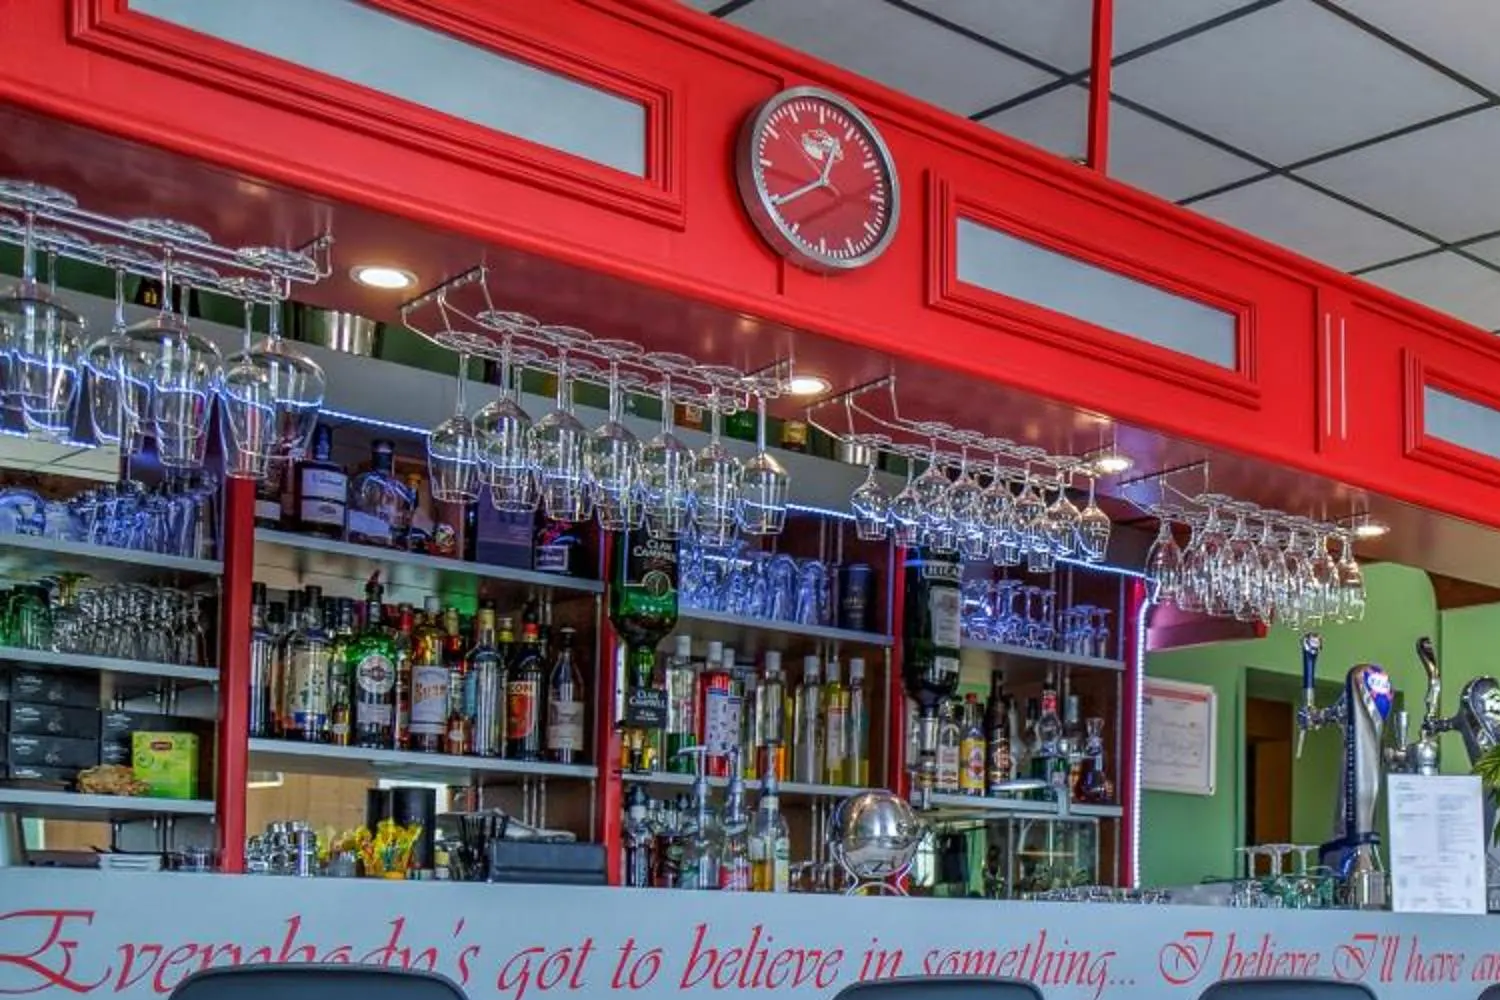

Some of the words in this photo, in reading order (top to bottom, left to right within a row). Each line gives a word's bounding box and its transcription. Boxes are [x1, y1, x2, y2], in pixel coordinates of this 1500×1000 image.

[611, 938, 663, 990] to
[679, 923, 844, 990] believe
[858, 937, 903, 985] in
[1159, 931, 1214, 985] I
[1220, 931, 1321, 977] believe
[1331, 931, 1401, 983] I'll
[1404, 934, 1465, 983] have
